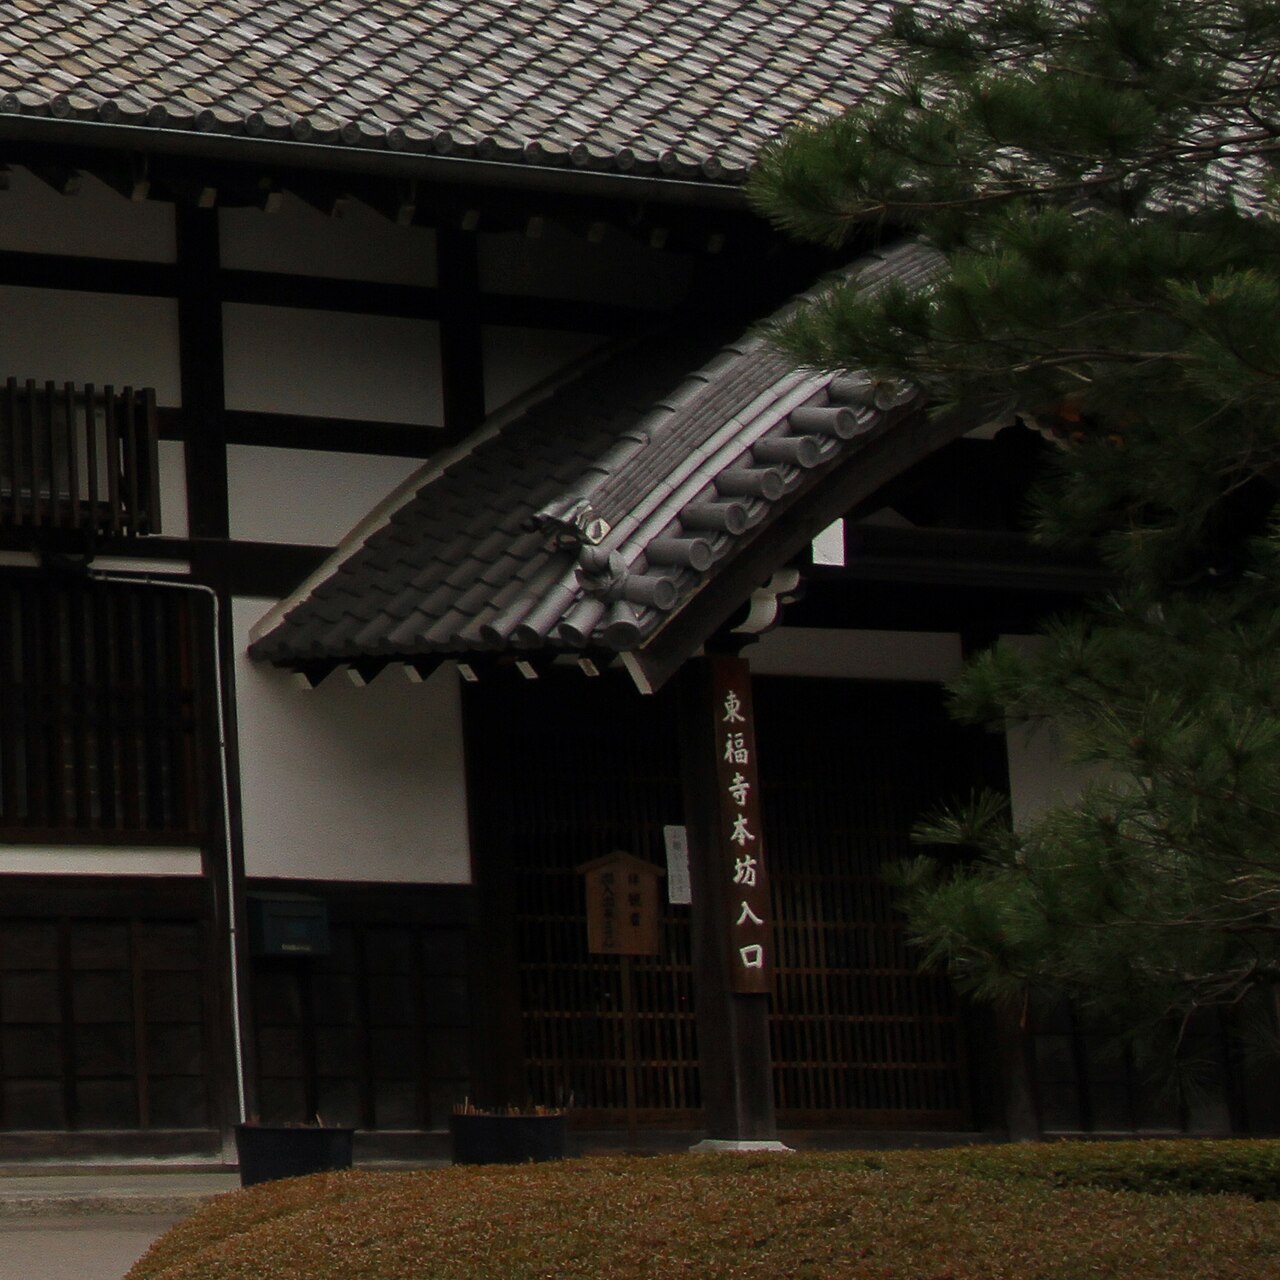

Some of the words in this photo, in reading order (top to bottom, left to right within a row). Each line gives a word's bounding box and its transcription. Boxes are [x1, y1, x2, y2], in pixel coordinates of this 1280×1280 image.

[722, 690, 764, 969] 東福寺本坊入口
